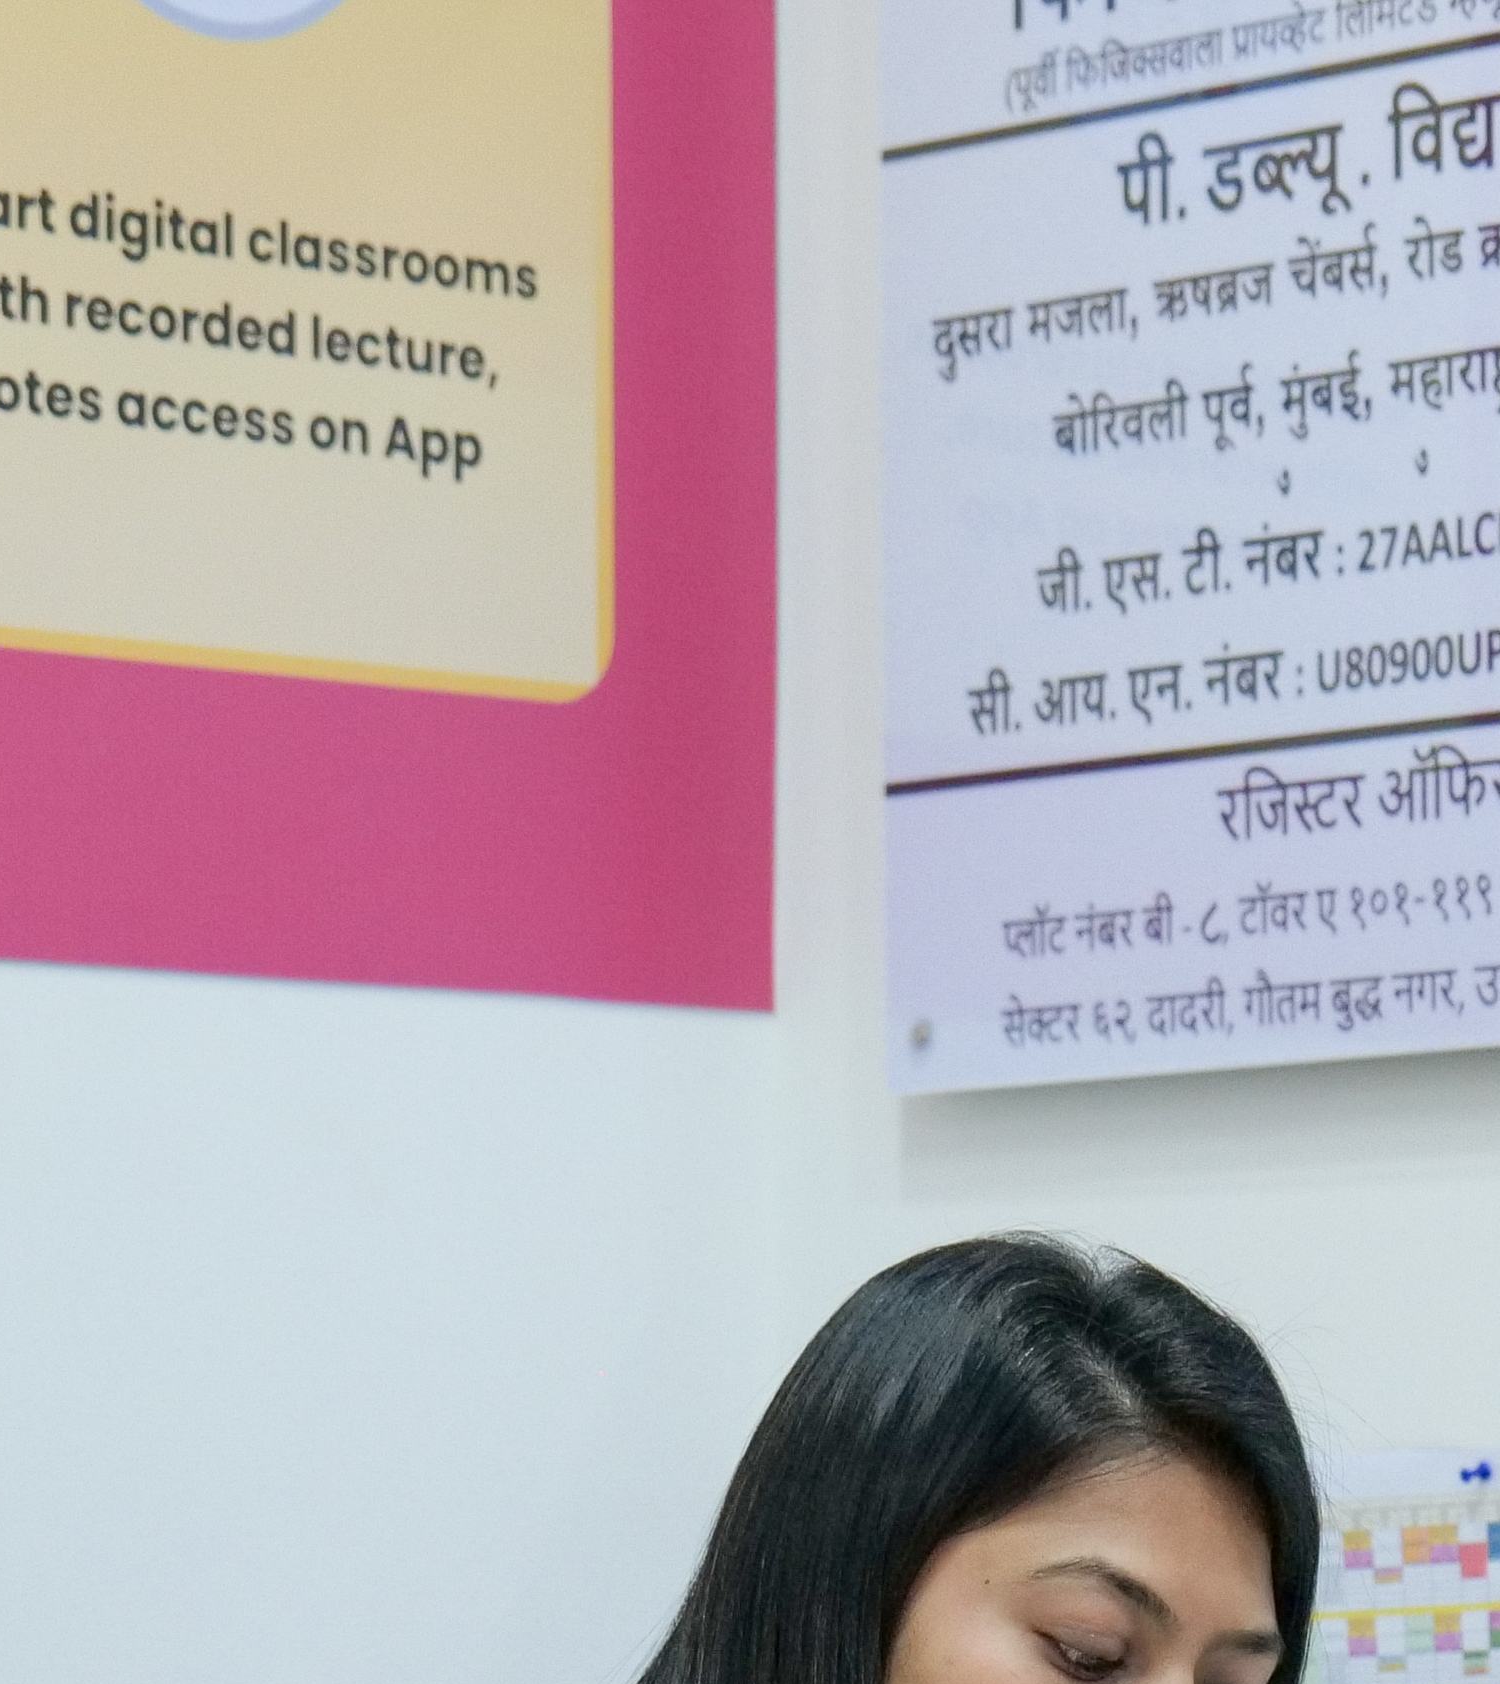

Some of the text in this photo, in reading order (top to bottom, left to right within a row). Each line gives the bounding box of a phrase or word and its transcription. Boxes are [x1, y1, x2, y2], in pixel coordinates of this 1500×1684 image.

[68, 190, 234, 265] digital
[247, 219, 538, 301] classrooms
[65, 290, 297, 358] recorded
[311, 312, 498, 390] lecture,
[116, 389, 295, 447] access
[308, 413, 370, 457] on
[384, 414, 483, 484] App
[1036, 545, 1092, 613] जी.
[1101, 551, 1171, 616] एस.
[1180, 526, 1232, 597] टी.
[1241, 522, 1325, 587] नंबर
[966, 665, 1022, 737] सी.
[1033, 671, 1117, 726] आय.
[1126, 661, 1193, 725] एन.
[1202, 641, 1285, 706] नंबर
[1215, 764, 1367, 842] रजिस्टर
